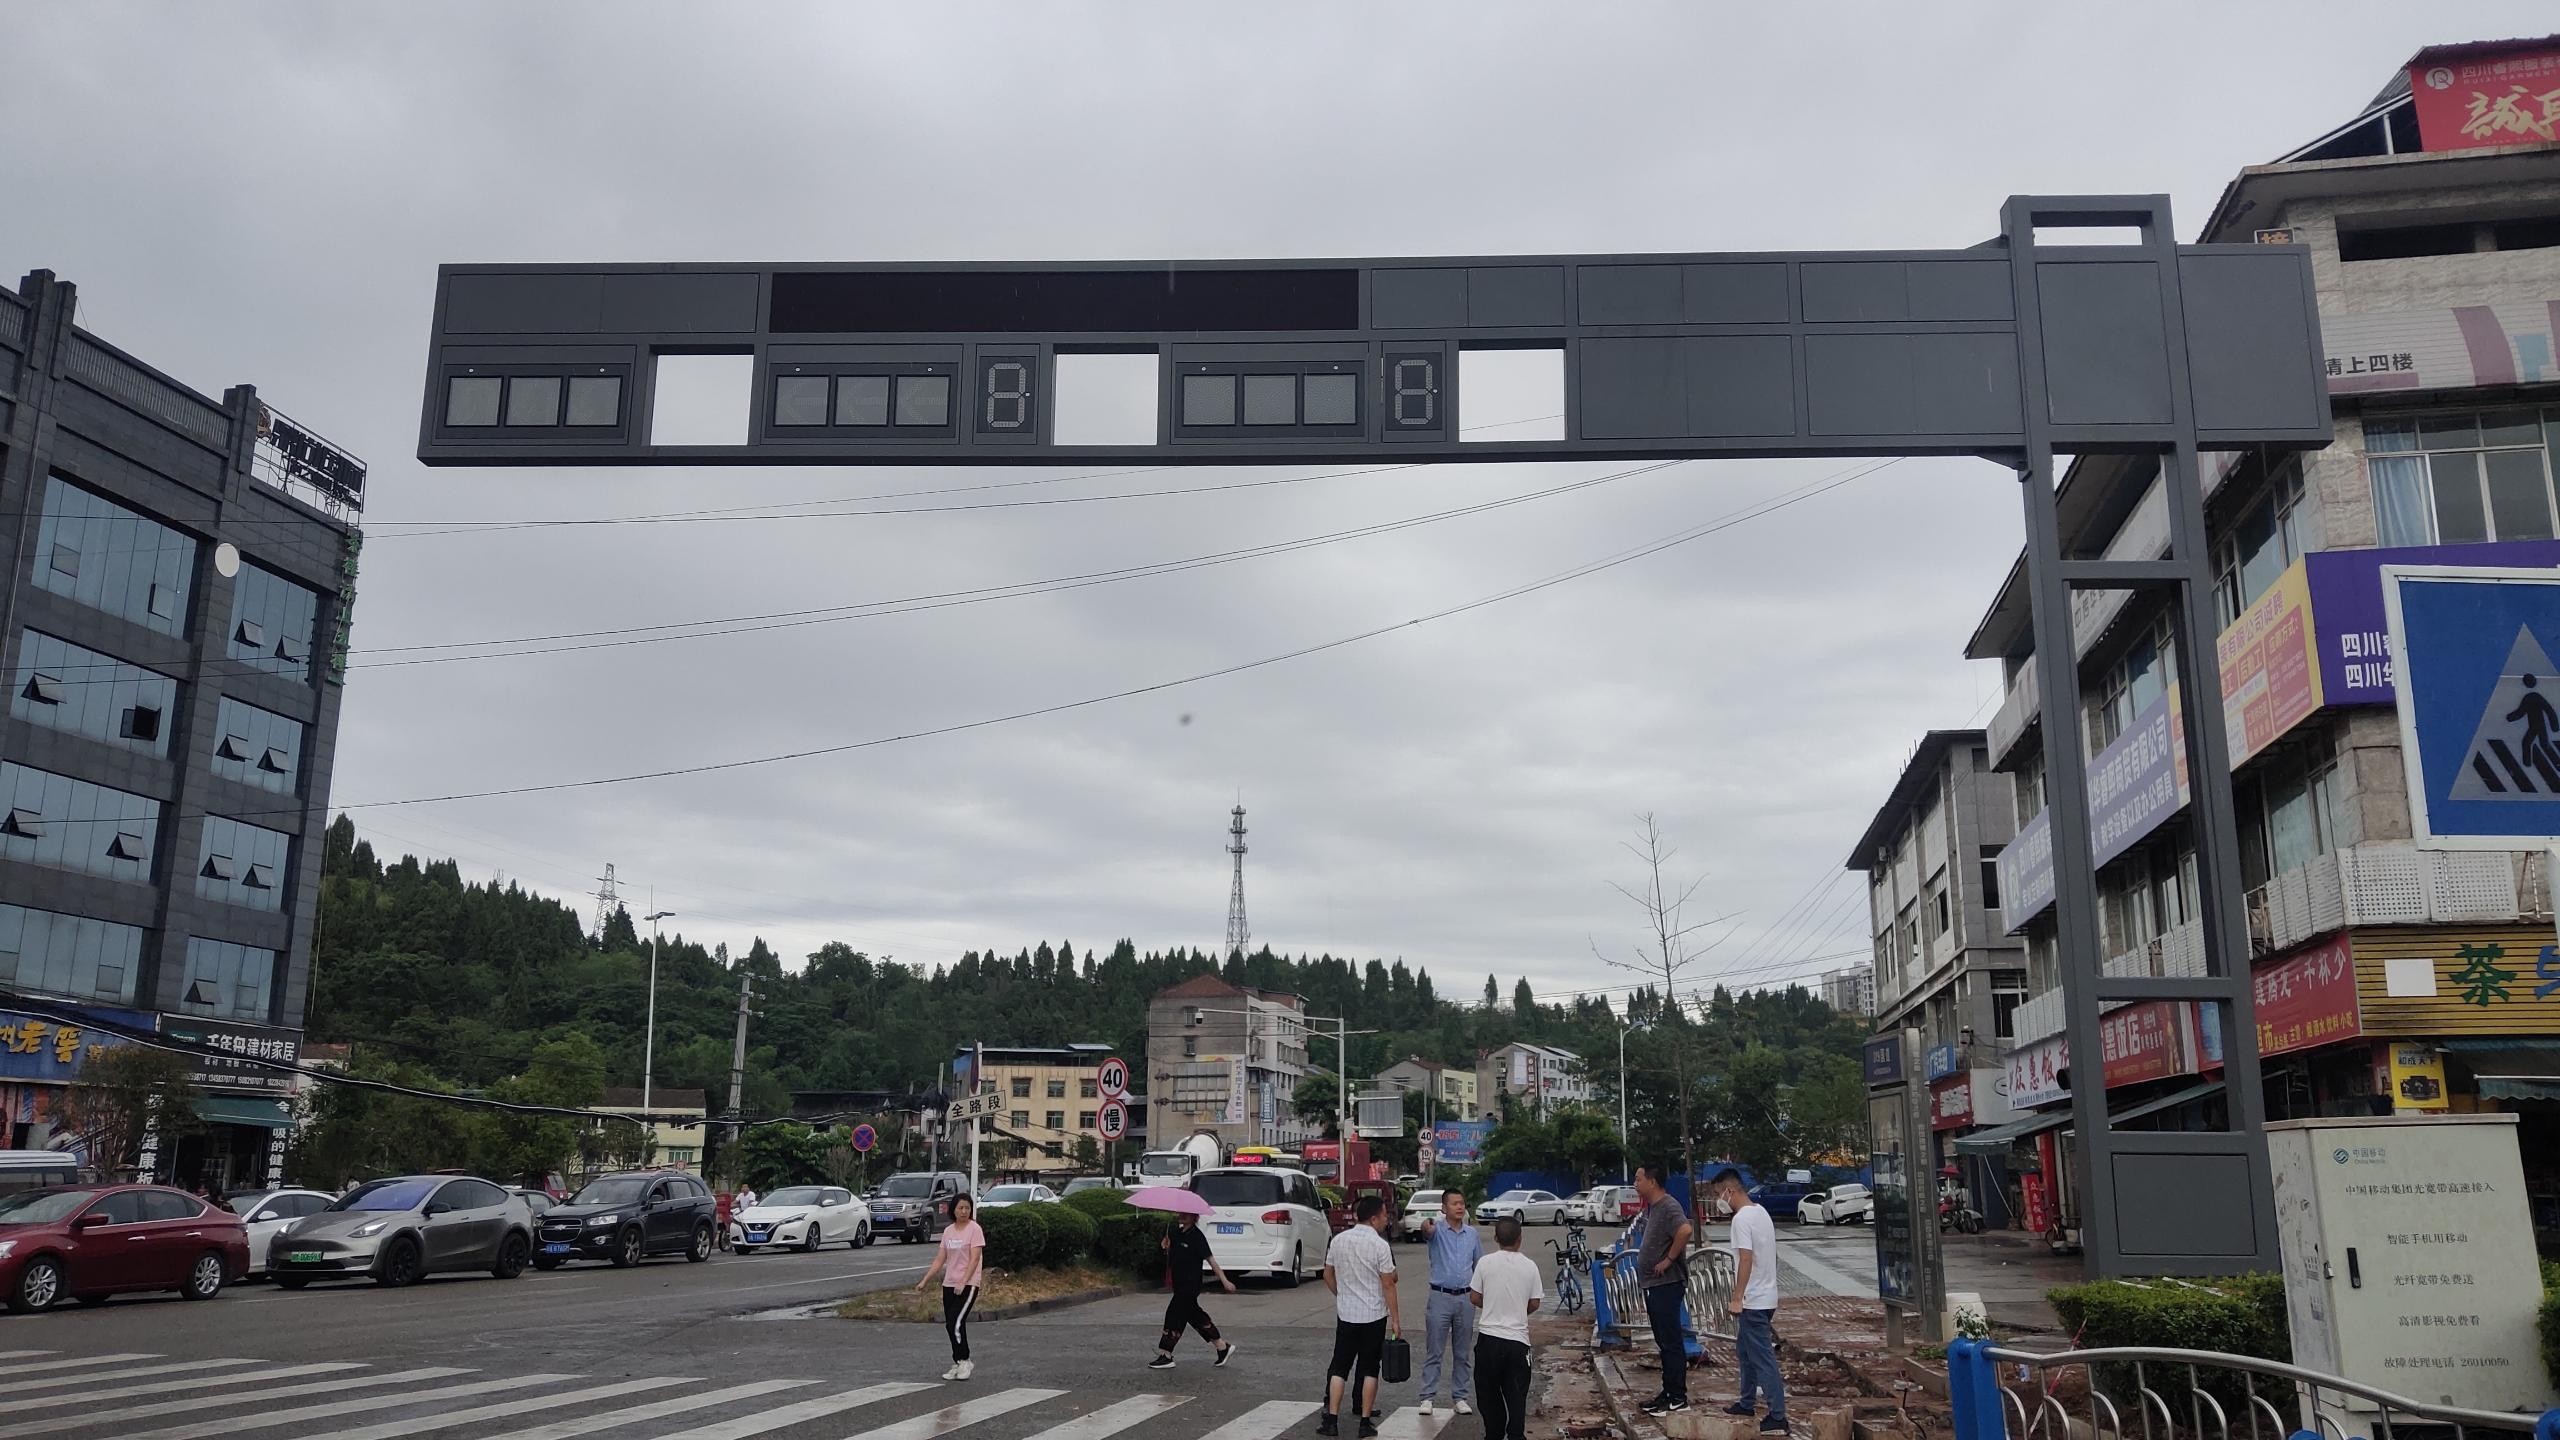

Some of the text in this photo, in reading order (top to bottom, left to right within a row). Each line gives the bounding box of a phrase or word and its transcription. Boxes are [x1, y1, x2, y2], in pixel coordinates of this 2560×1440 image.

[2325, 353, 2414, 376] 请上四楼
[1102, 1068, 1122, 1088] 40
[952, 1095, 1001, 1119] 全路段
[1103, 1108, 1121, 1132] 慢
[1420, 1131, 1432, 1141] 40
[266, 1100, 290, 1190] 会吸的健康板
[2352, 1148, 2386, 1158] 中国移动
[2345, 1181, 2495, 1195] 中国移动集团光宽带高速接入
[2387, 1233, 2468, 1245] 智能手机用移动
[2394, 1274, 2474, 1286] 光纤宽带免费送
[2399, 1315, 2480, 1328] 高清影视免费看
[2384, 1357, 2455, 1369] 故障处理电话
